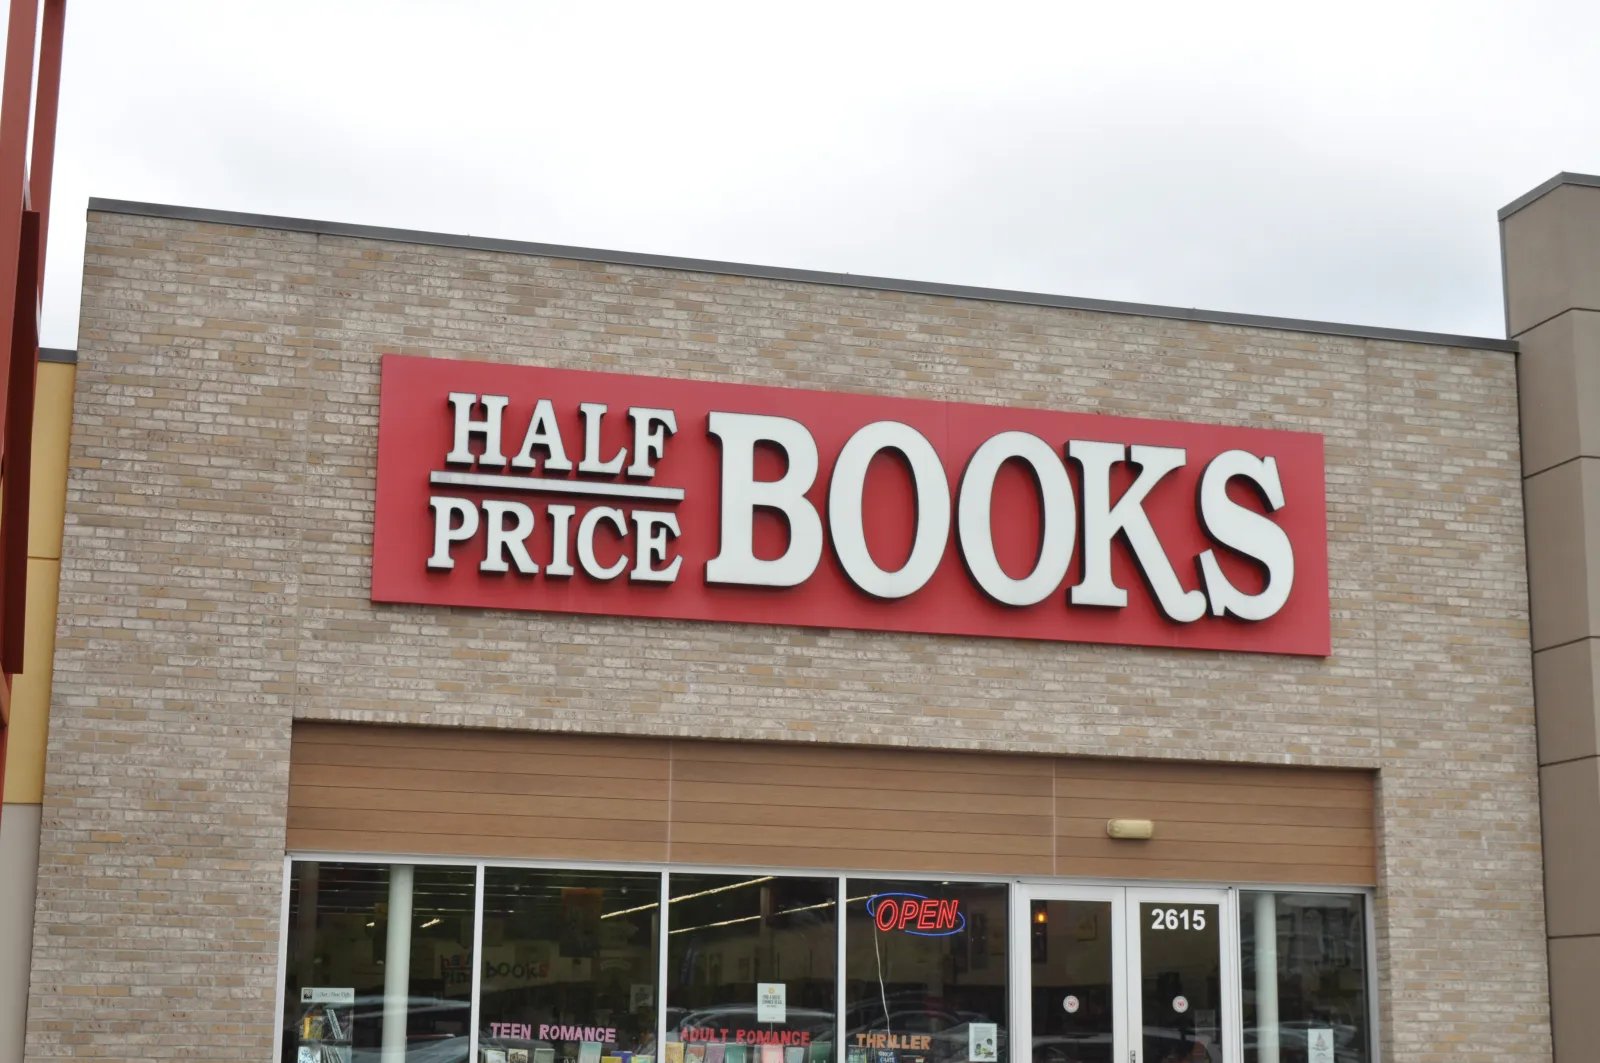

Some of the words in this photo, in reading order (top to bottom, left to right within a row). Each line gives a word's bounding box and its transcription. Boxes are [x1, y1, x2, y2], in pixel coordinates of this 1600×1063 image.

[446, 392, 678, 477] HALF
[704, 410, 1295, 623] BOOKS
[427, 496, 683, 582] PRICE
[876, 899, 959, 932] OPEN
[1151, 908, 1206, 931] 2615
[490, 1022, 531, 1040] TEEN
[539, 1024, 616, 1043] ROMANCE
[680, 1026, 729, 1043] ADULT
[736, 1029, 811, 1046] ROMANCE
[856, 1033, 932, 1050] THRILLER
